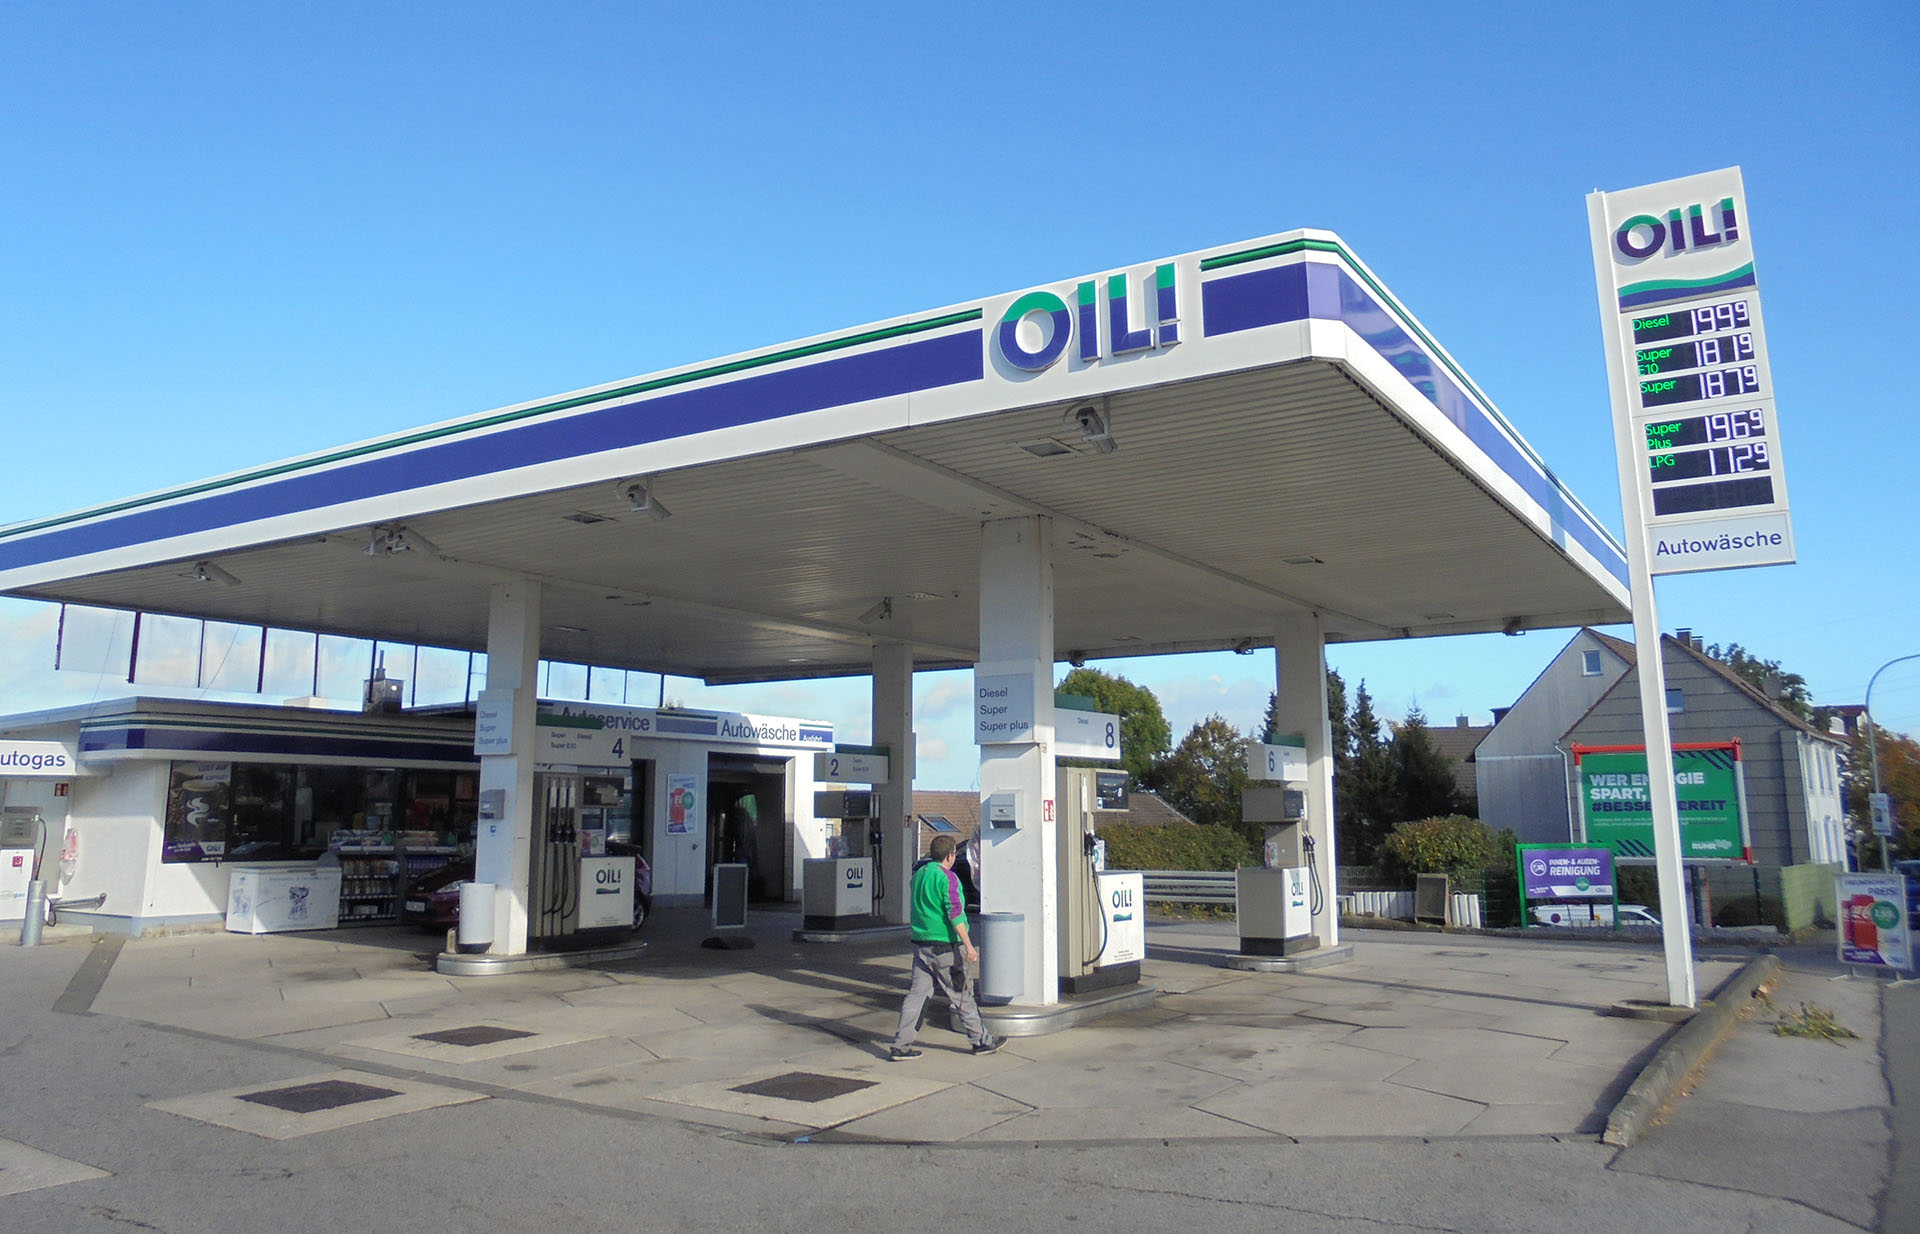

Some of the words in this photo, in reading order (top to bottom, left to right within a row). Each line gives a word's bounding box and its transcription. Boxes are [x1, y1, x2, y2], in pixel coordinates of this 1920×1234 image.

[1616, 197, 1739, 259] OIL!
[998, 262, 1182, 371] OIL!
[1632, 314, 1669, 332] Diesel
[1690, 302, 1748, 335] 1999
[1636, 348, 1672, 362] Super
[1695, 333, 1753, 367] 1819
[1638, 363, 1659, 376] E10
[1640, 380, 1676, 395] Super
[1699, 366, 1758, 400] 1879
[1645, 421, 1681, 436] Super
[1704, 409, 1764, 443] 1969
[1647, 437, 1672, 450] Plus
[1649, 454, 1675, 468] LPG
[1709, 442, 1769, 476] 1129
[1656, 531, 1782, 556] Autowäsche
[979, 688, 1008, 698] Diesel
[979, 705, 1008, 716] Super
[721, 719, 797, 741] Autowäsche
[979, 722, 1007, 733] Super
[1009, 720, 1029, 732] plus
[1105, 722, 1115, 749] 8
[612, 737, 624, 759] 4
[0, 750, 66, 770] utogas
[831, 758, 839, 777] 2
[1268, 750, 1275, 772] 6
[1589, 774, 1629, 786] WER
[1589, 787, 1647, 802] SPART,
[596, 869, 621, 884] OIL!
[847, 867, 864, 880] OIL!
[1550, 866, 1601, 876] REINIGUNG
[1112, 889, 1132, 908] OIL!
[1291, 882, 1304, 896] OIL!
